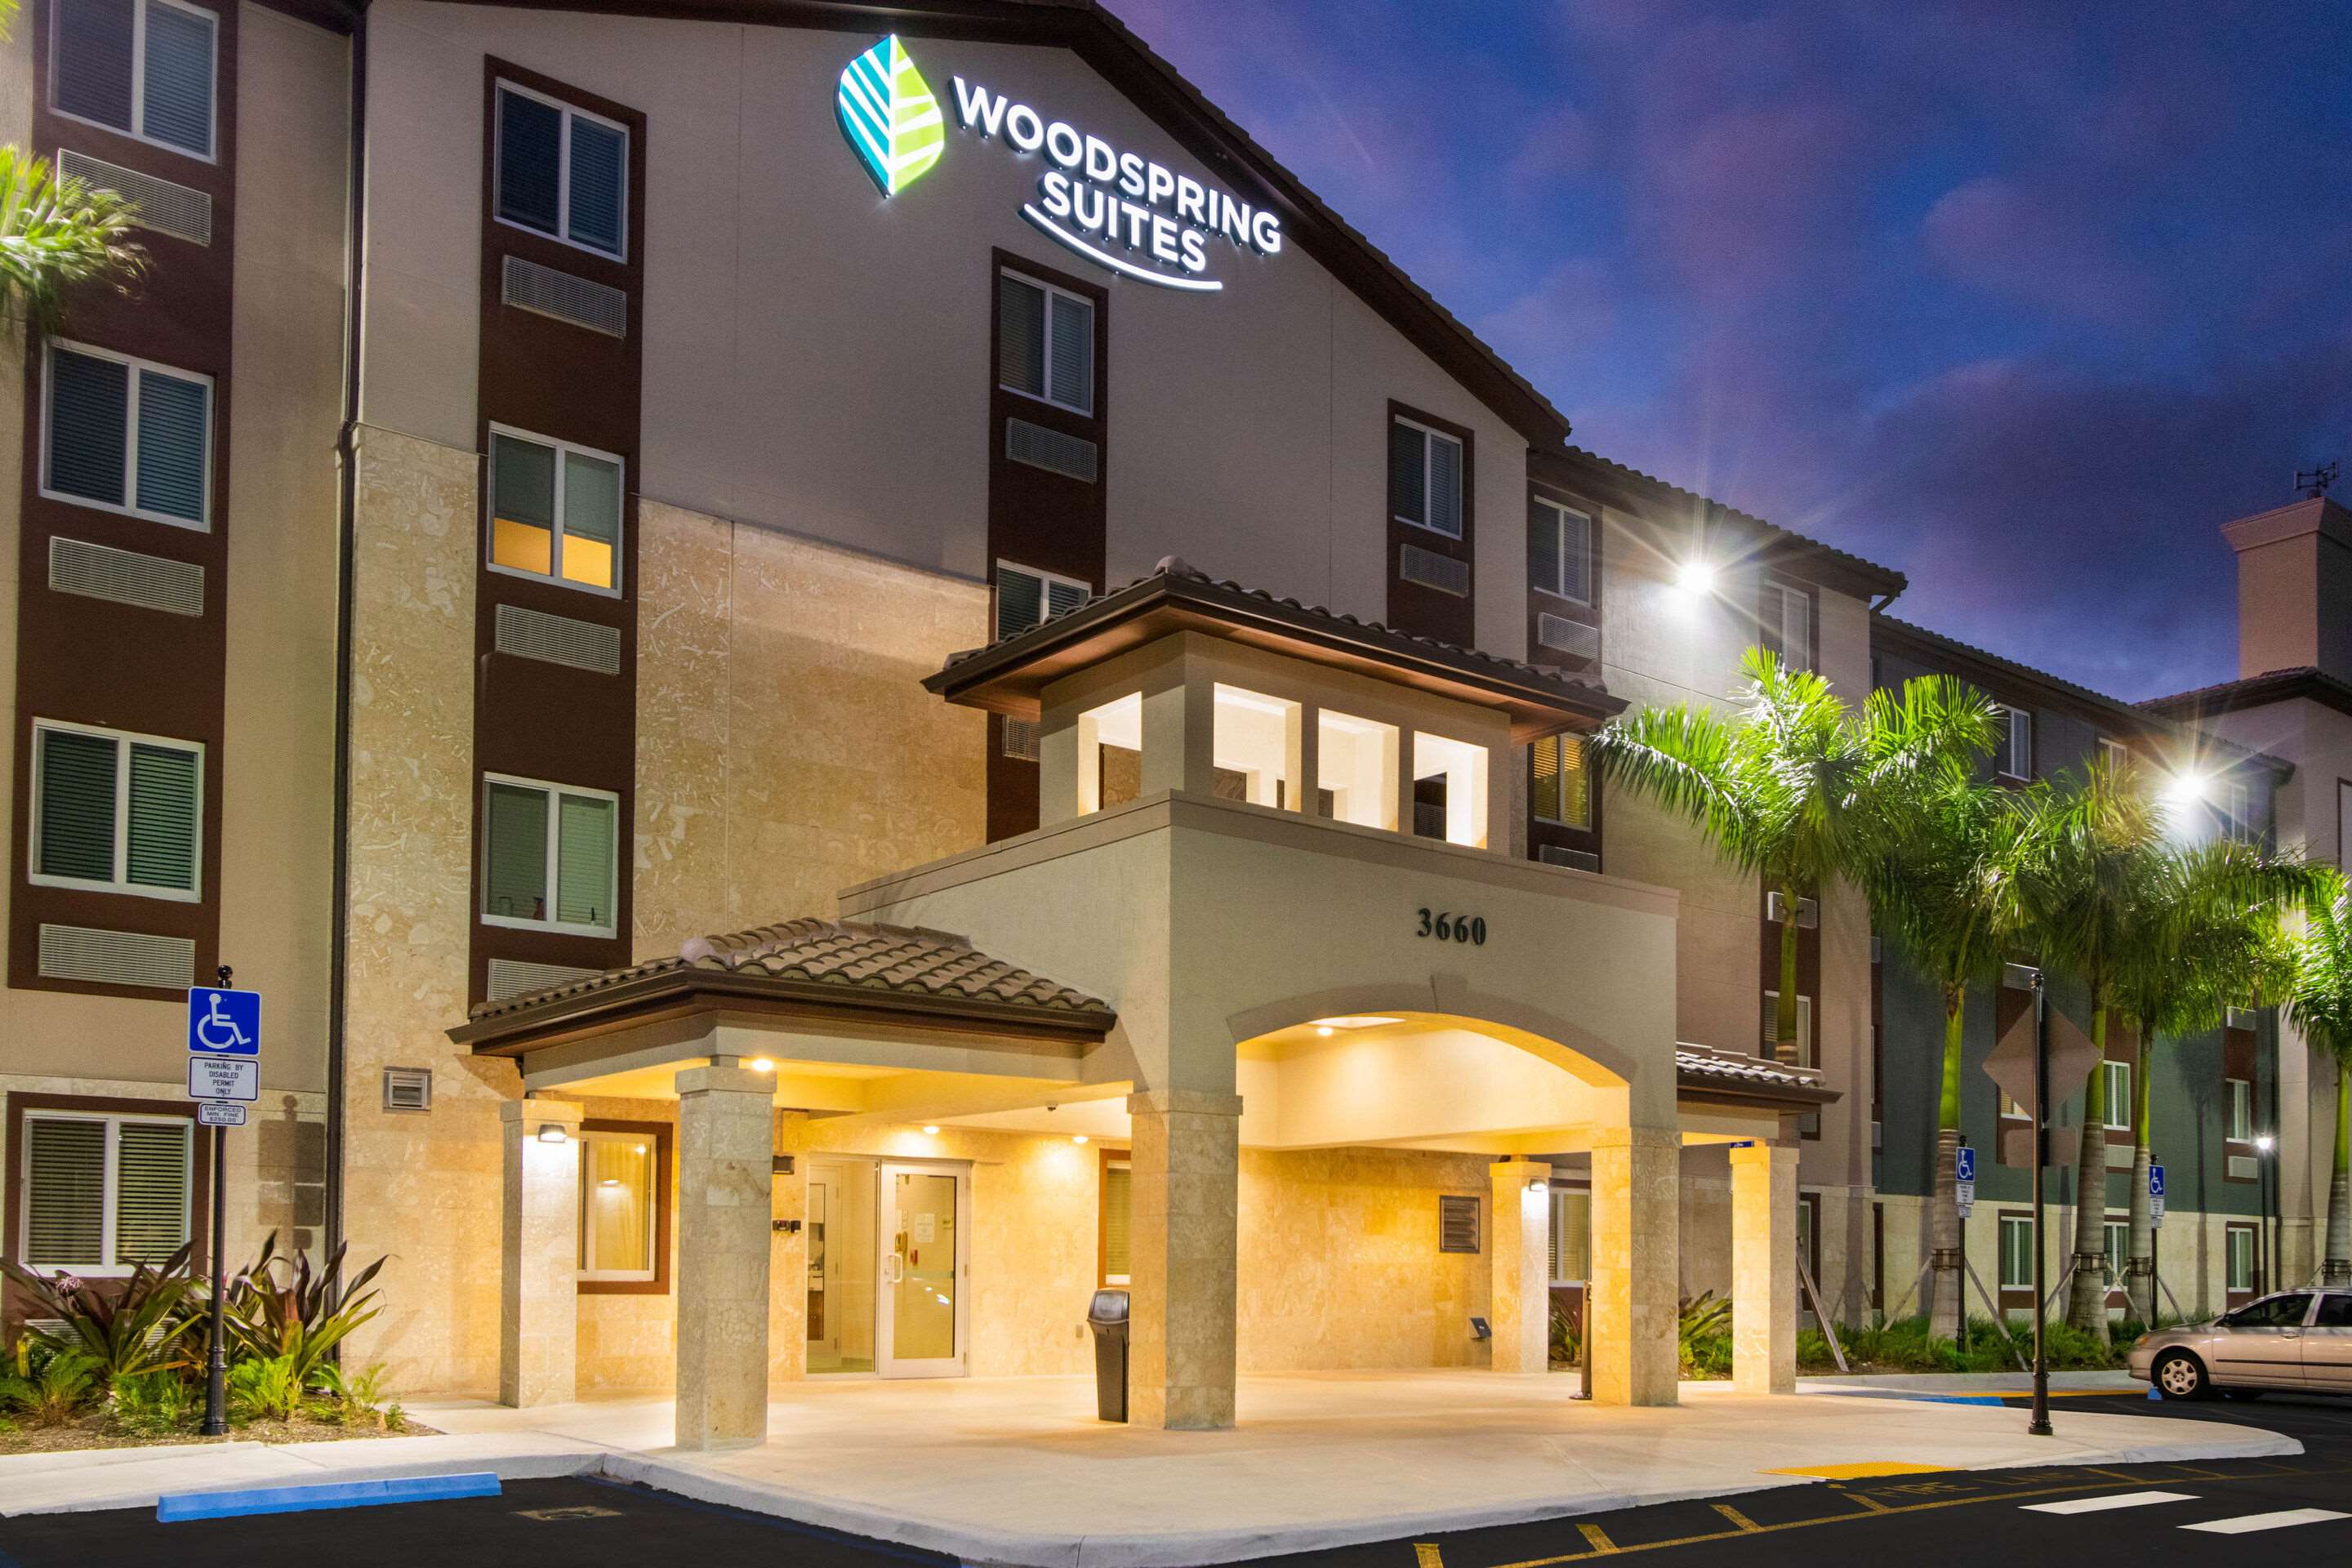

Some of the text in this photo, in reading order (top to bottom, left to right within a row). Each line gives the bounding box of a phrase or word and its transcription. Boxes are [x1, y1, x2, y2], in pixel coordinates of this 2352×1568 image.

[951, 75, 1281, 254] WOODSPRING
[1040, 169, 1207, 272] SUITES
[1417, 907, 1486, 945] 3660
[204, 1062, 231, 1070] PARKING
[209, 1071, 239, 1079] DISABLED
